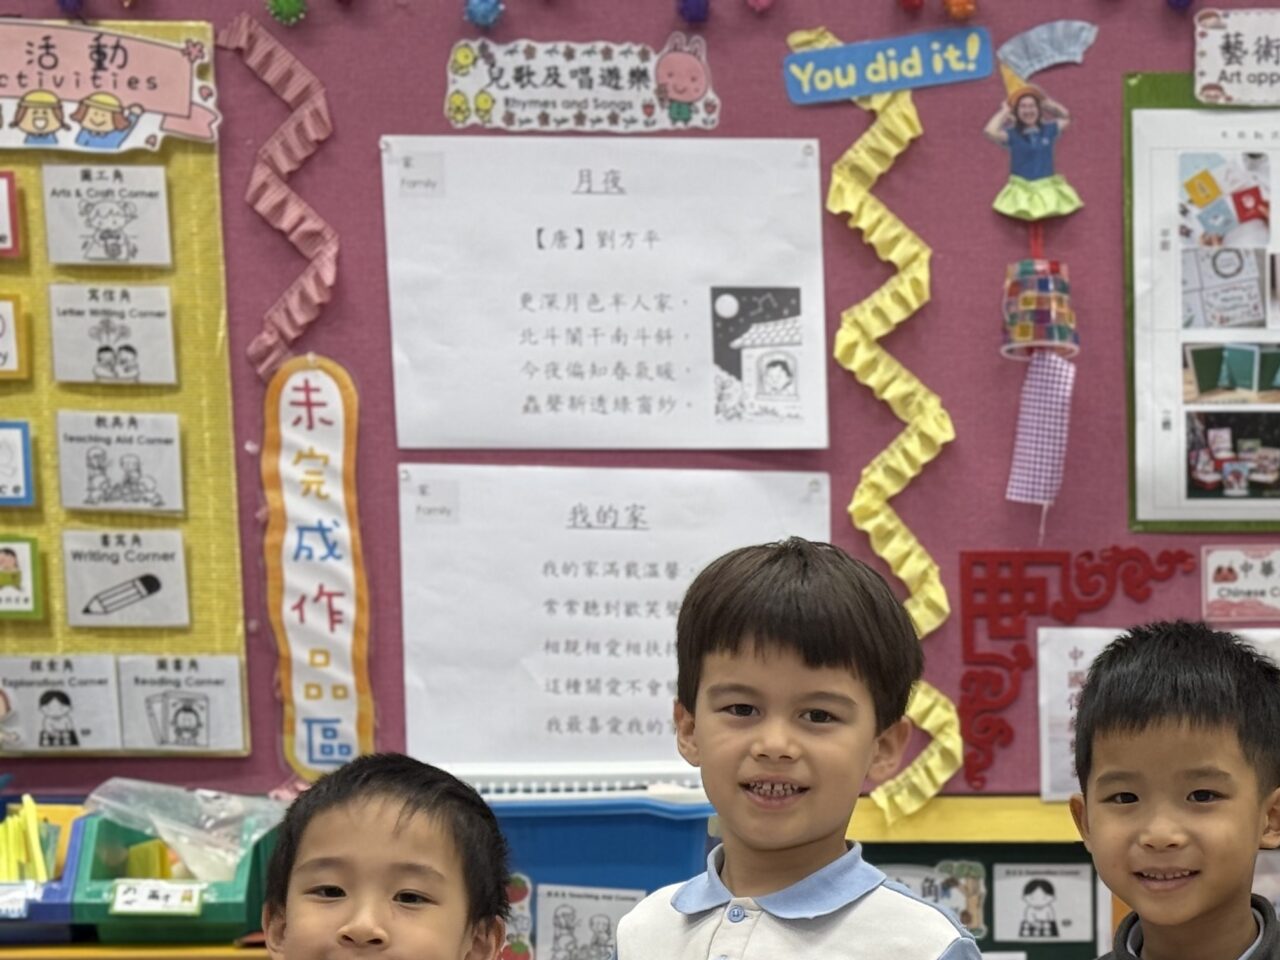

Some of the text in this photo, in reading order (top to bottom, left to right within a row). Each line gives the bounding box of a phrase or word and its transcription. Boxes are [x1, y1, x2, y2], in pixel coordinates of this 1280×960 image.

[789, 33, 980, 94] You did it!
[1217, 70, 1242, 83] Art
[562, 98, 588, 110] and
[593, 98, 634, 112] Songs
[574, 168, 627, 194] 月夜
[119, 189, 160, 199] Corner
[129, 309, 167, 318] Corner
[137, 435, 174, 446] Corner
[567, 504, 649, 529] 我的家
[71, 550, 176, 564] Writing Corner
[289, 378, 353, 767] 未完成作品區
[1218, 587, 1265, 598] Chinese
[68, 677, 108, 687] Corner
[185, 677, 225, 687] Corner
